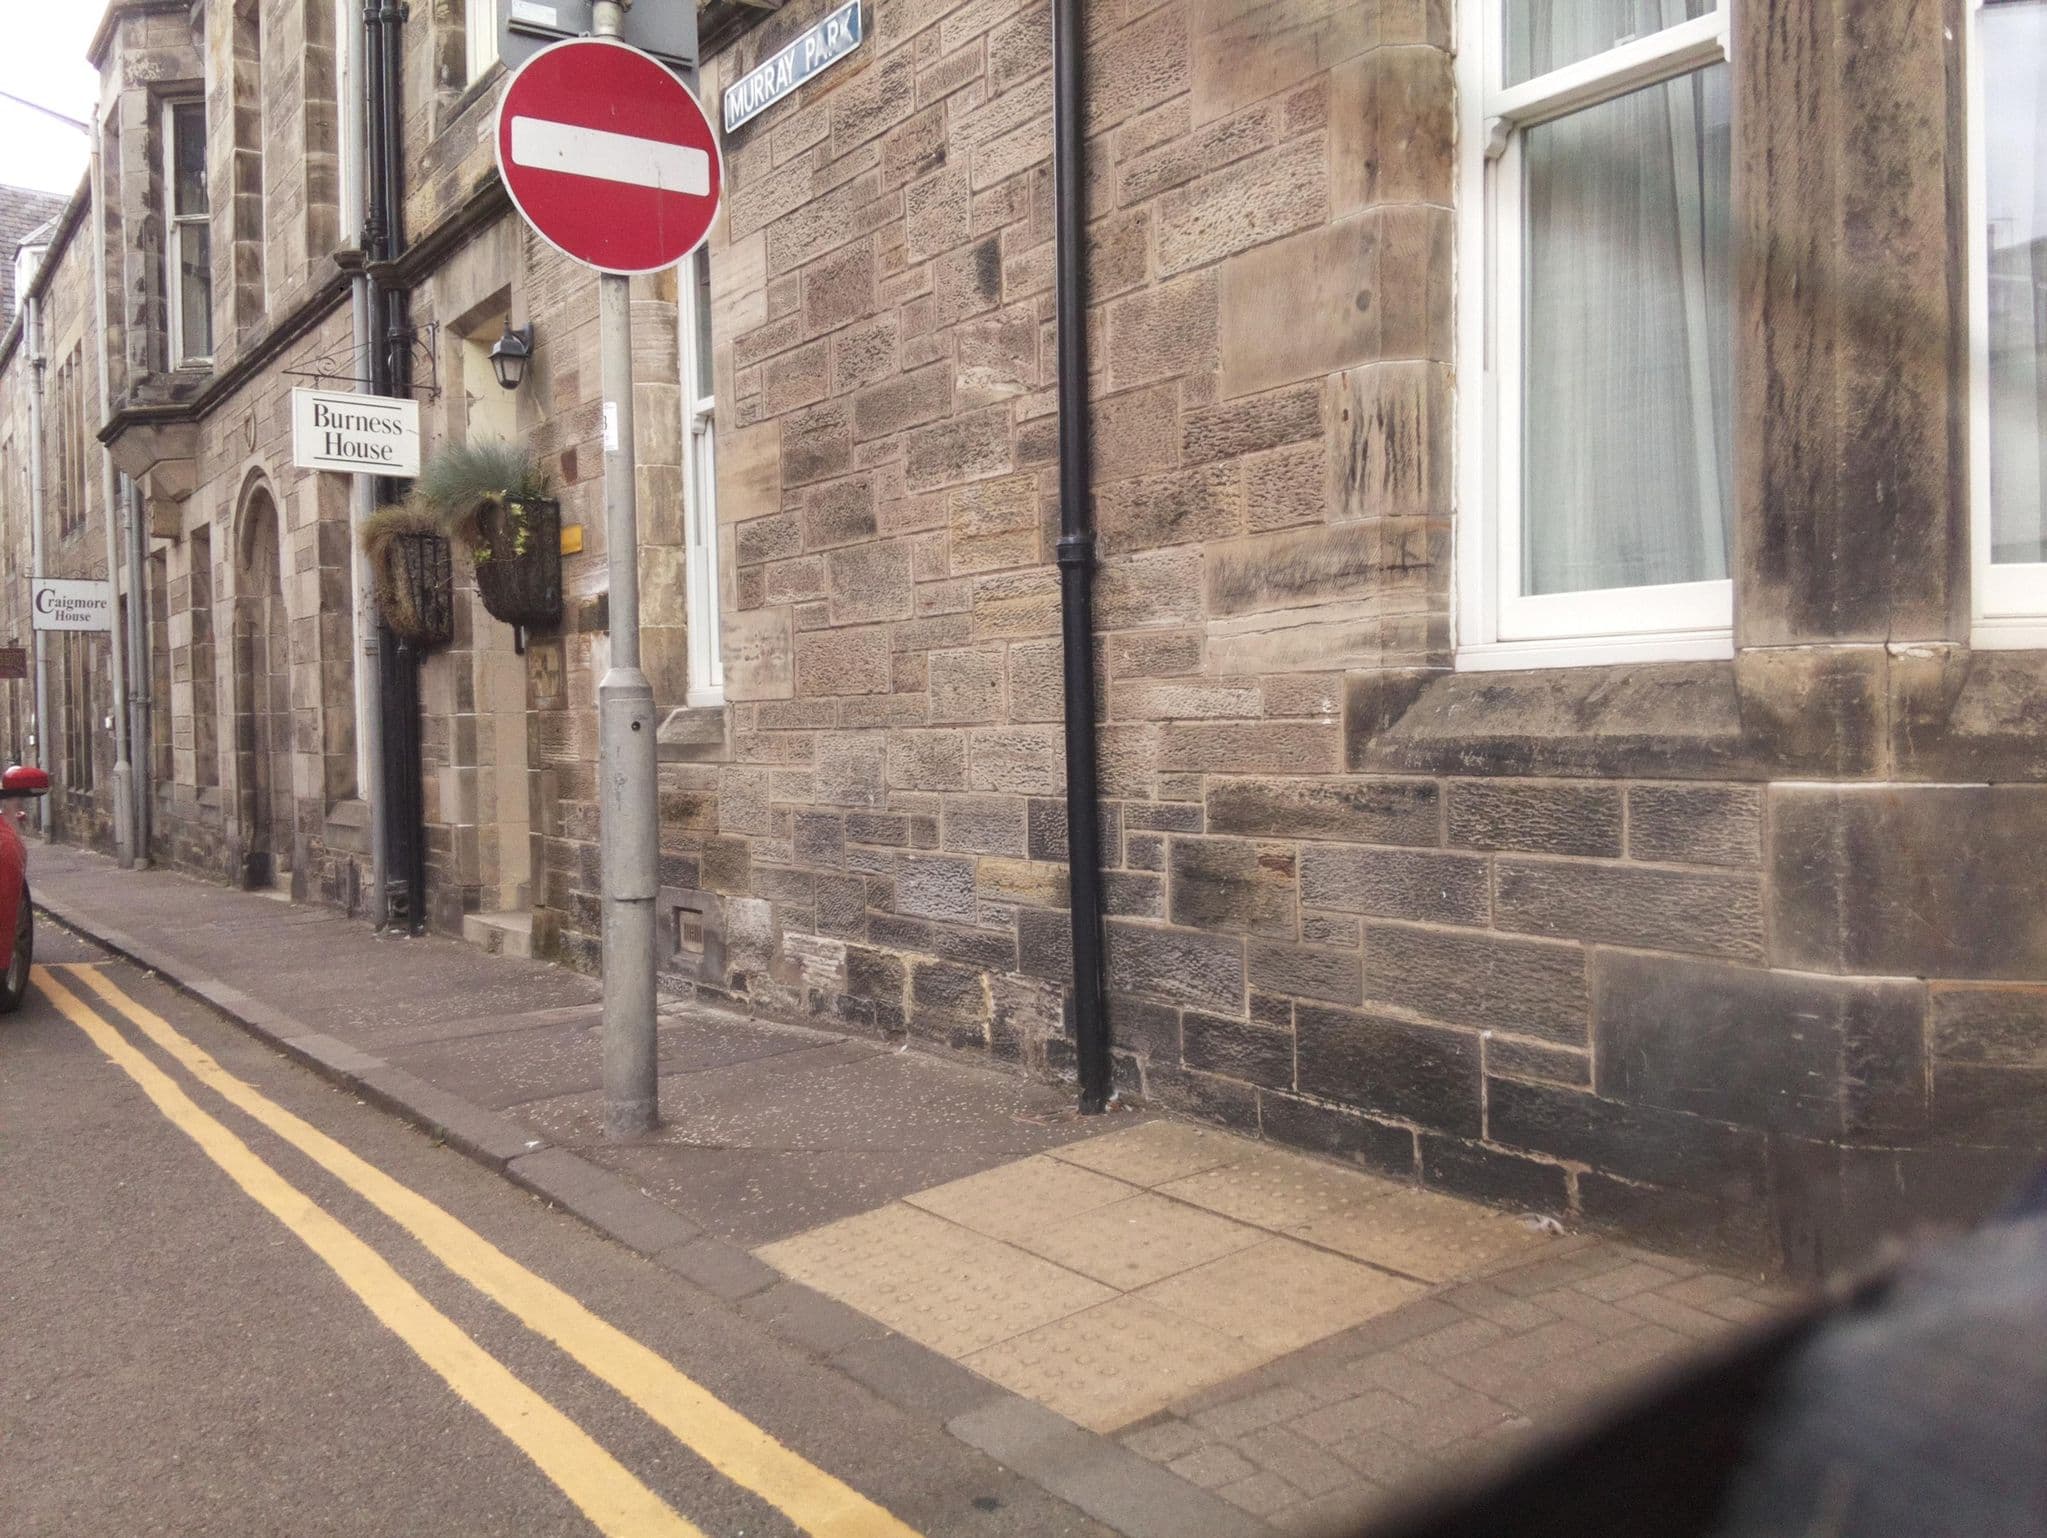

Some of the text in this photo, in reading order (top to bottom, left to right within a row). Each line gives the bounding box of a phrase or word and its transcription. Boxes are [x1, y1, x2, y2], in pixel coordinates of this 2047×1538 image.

[729, 7, 855, 124] MURRAY PARK
[313, 403, 403, 436] Burness
[325, 431, 393, 461] House
[35, 588, 108, 614] Craigmore
[55, 609, 92, 622] House
